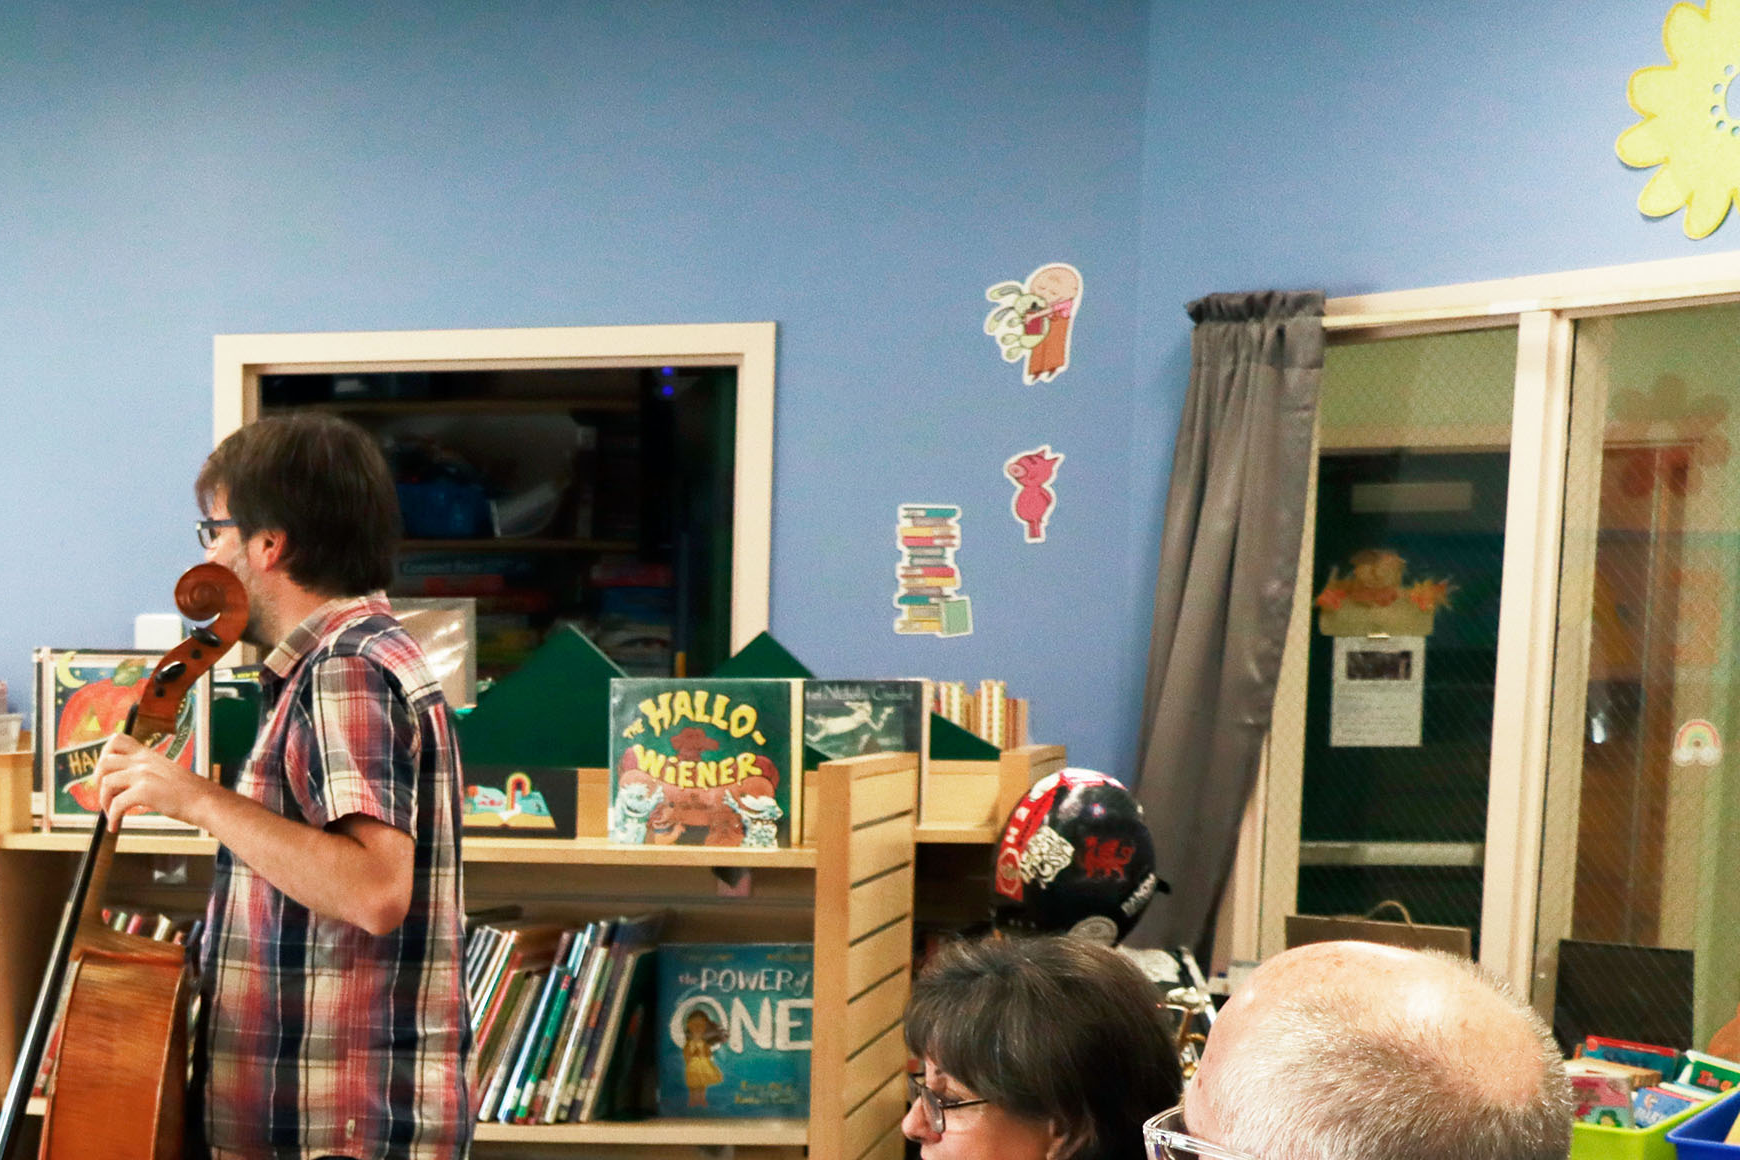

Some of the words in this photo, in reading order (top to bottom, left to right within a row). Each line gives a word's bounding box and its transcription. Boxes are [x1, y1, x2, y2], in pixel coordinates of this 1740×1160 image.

[622, 718, 645, 739] THE
[638, 690, 767, 746] HALLO-
[700, 968, 794, 992] POWER
[670, 995, 815, 1054] ONE
